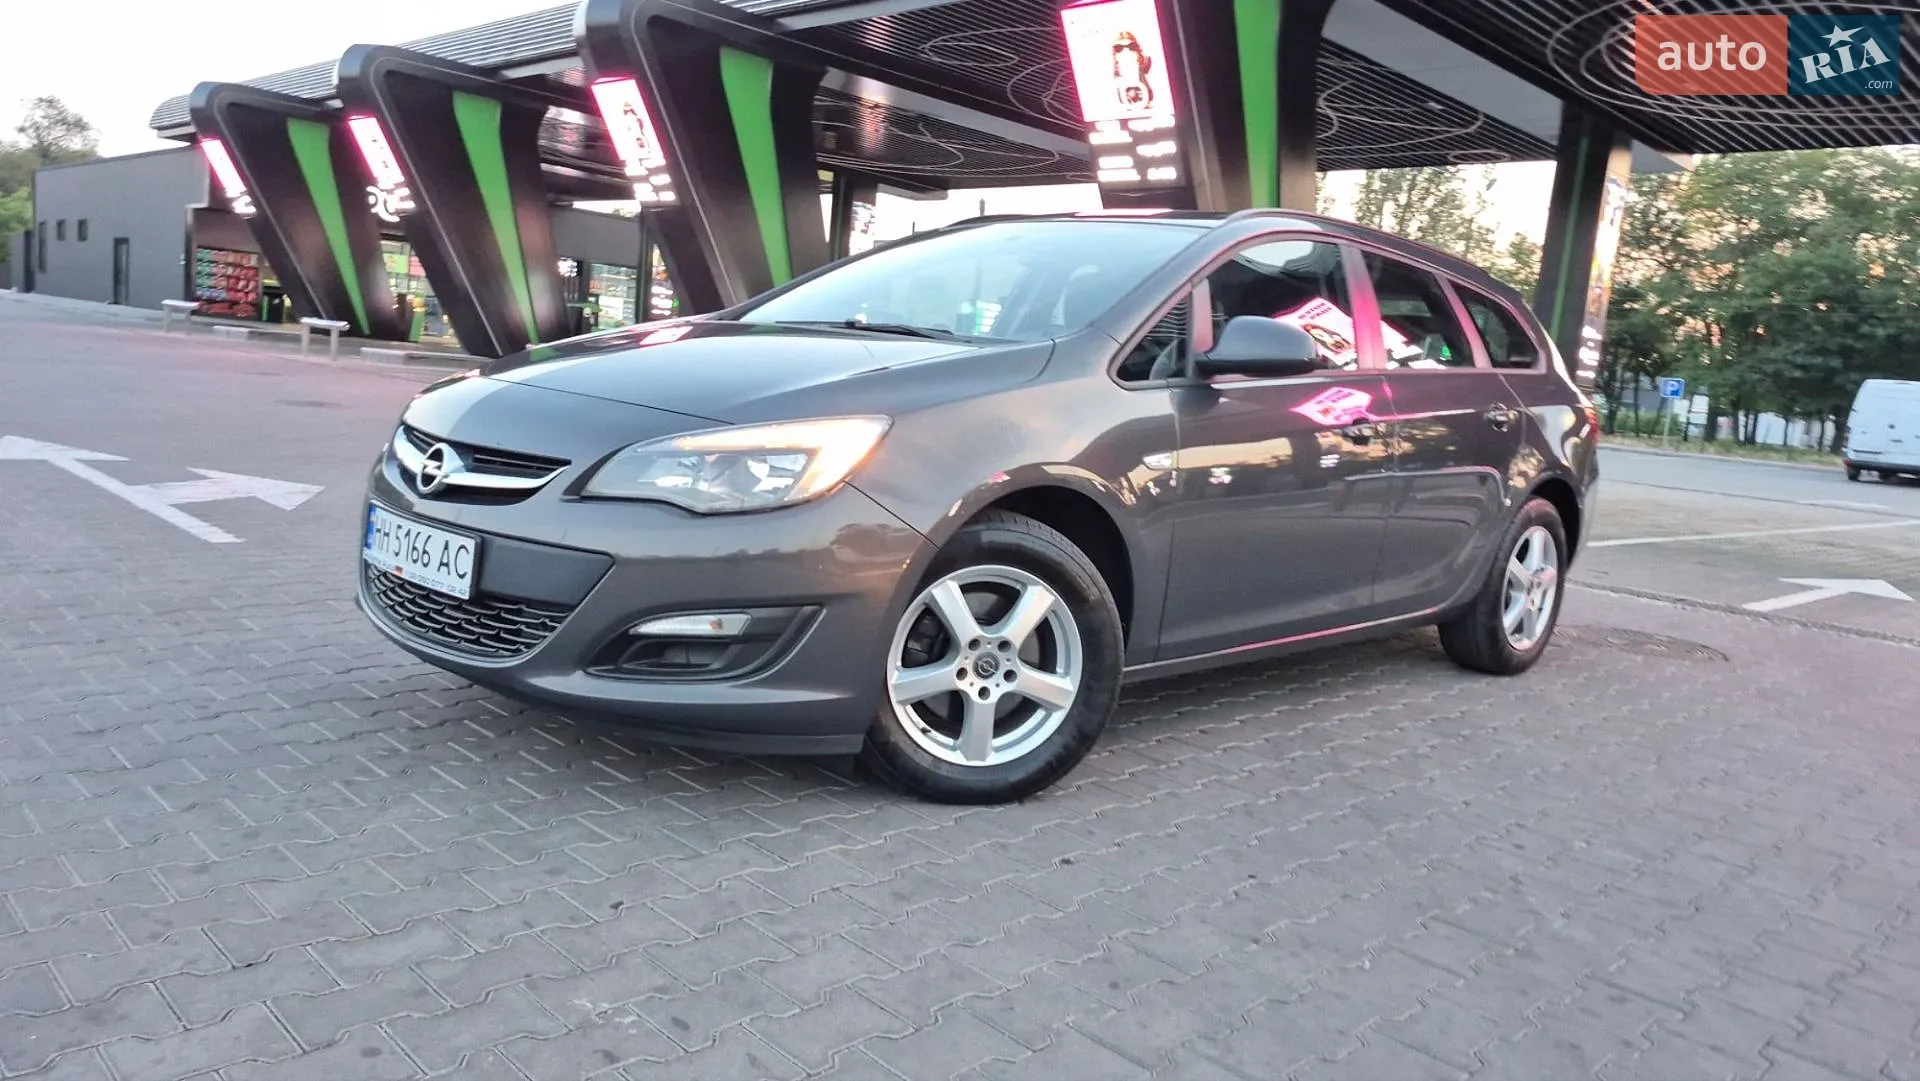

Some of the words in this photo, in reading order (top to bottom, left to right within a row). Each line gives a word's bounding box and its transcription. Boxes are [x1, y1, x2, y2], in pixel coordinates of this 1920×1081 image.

[1666, 380, 1680, 396] P
[394, 524, 432, 568] 5166
[437, 539, 470, 580] AC
